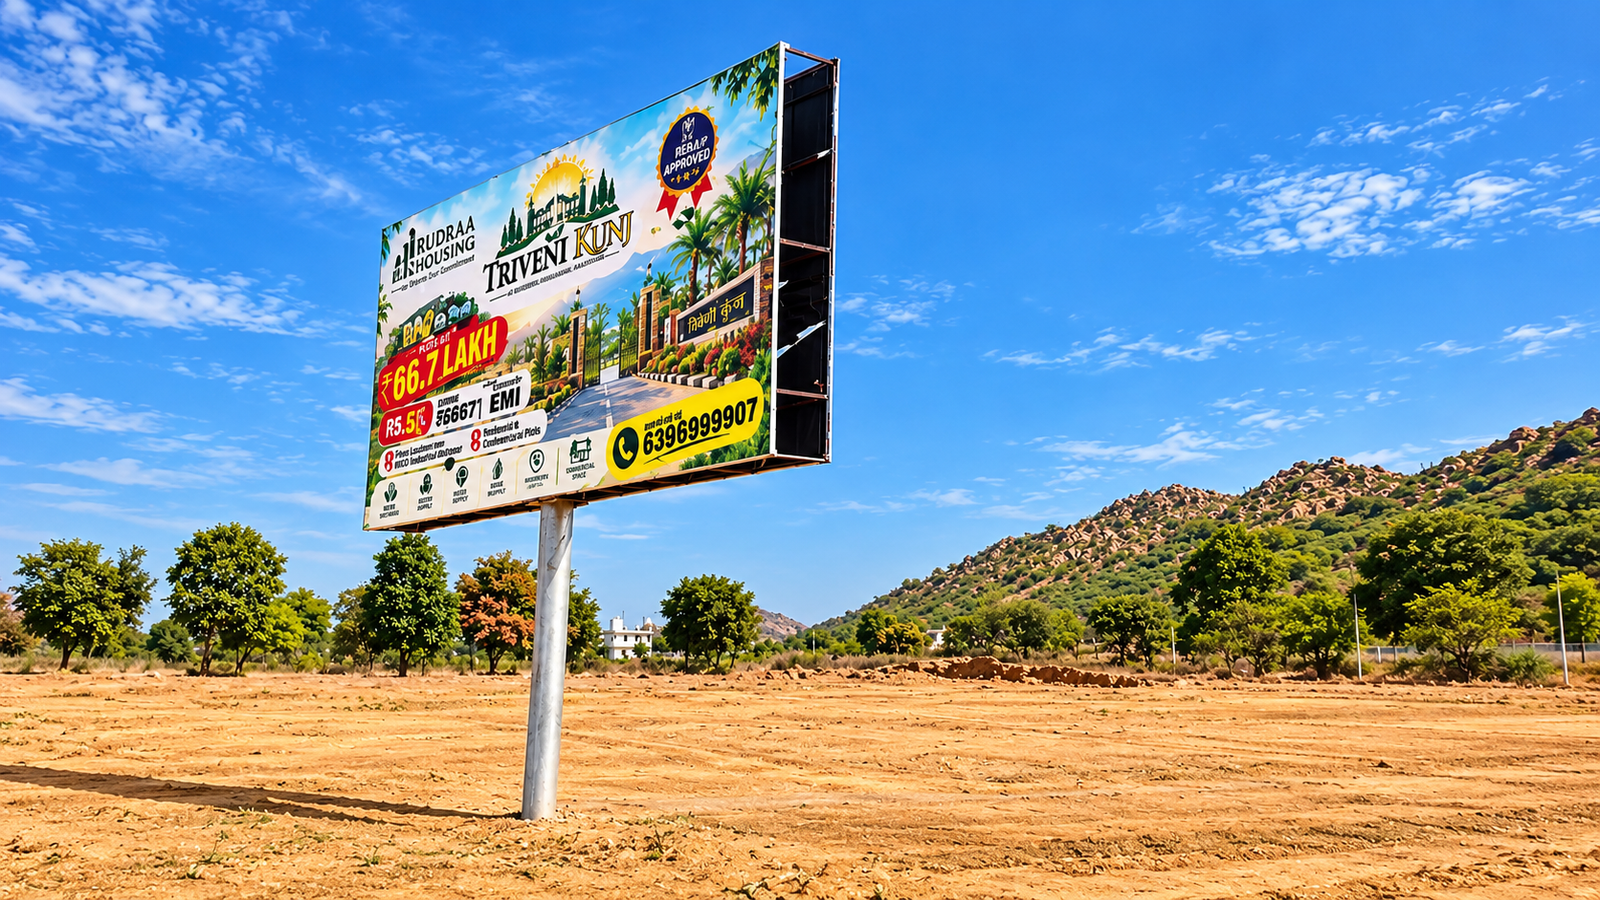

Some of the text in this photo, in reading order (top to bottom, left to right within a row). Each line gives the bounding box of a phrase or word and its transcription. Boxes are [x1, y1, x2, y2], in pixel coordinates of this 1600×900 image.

[663, 147, 711, 177] APPROVED
[415, 234, 476, 274] HOUSING
[417, 215, 476, 256] RUDRAA
[482, 235, 569, 294] TRIVENI
[572, 210, 634, 261] KUNJ
[442, 320, 498, 378] LAKH
[489, 385, 521, 414] EMI
[643, 396, 759, 456] 6396999907
